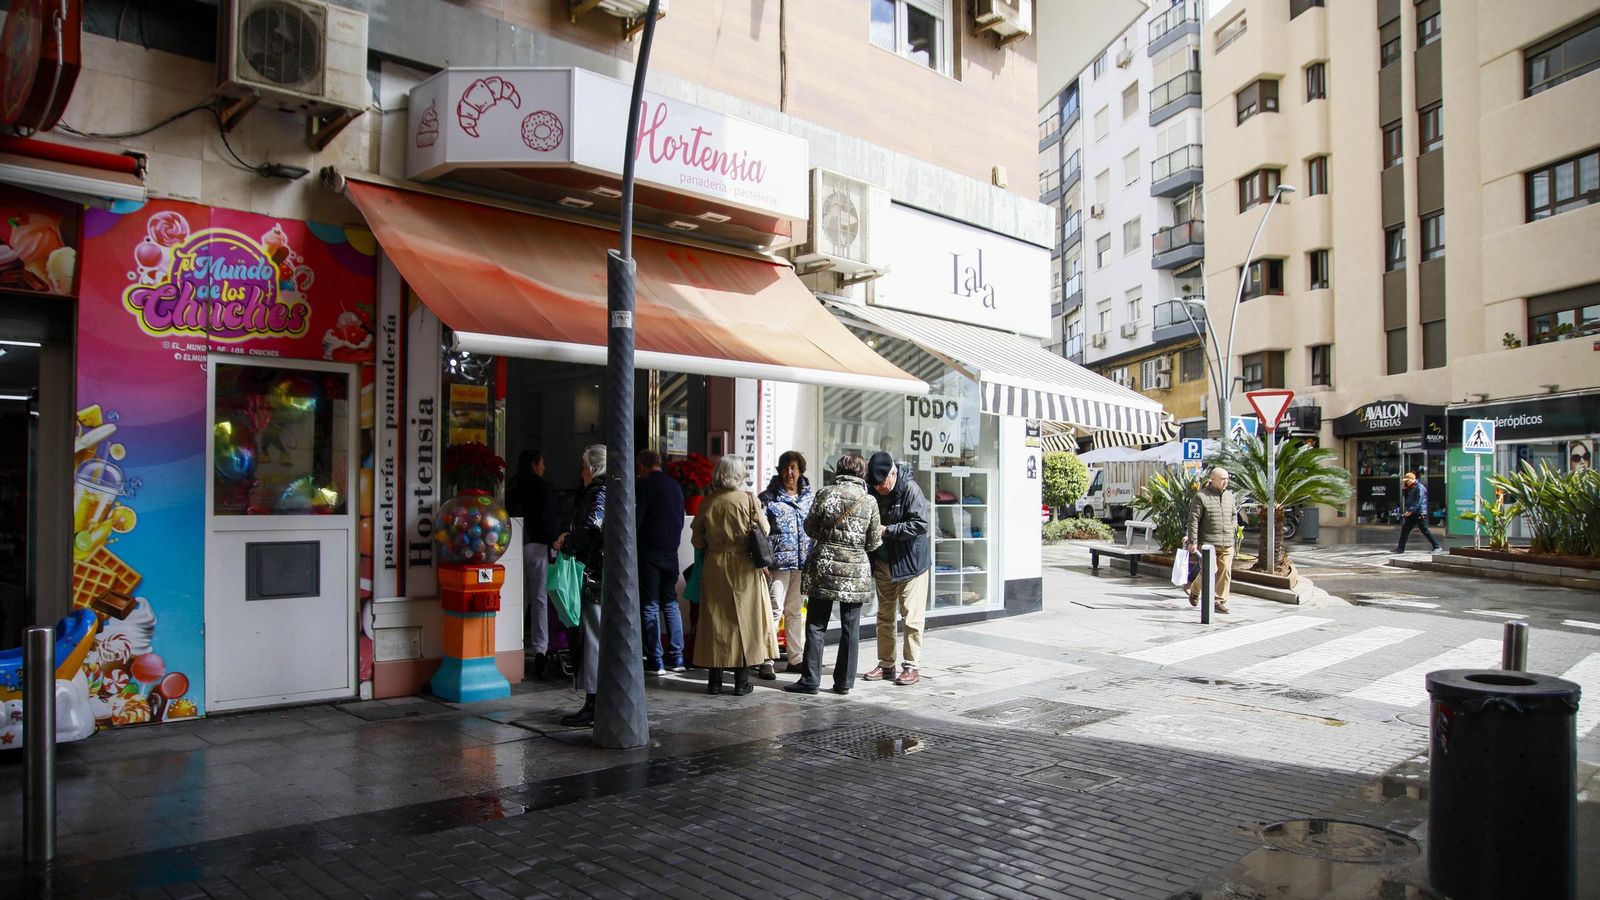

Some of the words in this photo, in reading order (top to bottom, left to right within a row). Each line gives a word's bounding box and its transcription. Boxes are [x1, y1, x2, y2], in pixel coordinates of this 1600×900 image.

[635, 101, 766, 184] Hortensia
[194, 255, 273, 282] Mundo
[949, 248, 996, 310] Lala
[129, 281, 308, 335] Chuches
[196, 278, 220, 300] de
[221, 280, 246, 302] los
[382, 313, 398, 430] panadería
[906, 395, 959, 421] TODO
[1364, 402, 1409, 421] AVALON
[1369, 418, 1402, 429] ESTILISTAS
[910, 430, 933, 452] 50
[939, 431, 954, 454] %
[408, 396, 434, 569] Hortensia
[380, 456, 397, 571] pastelería
